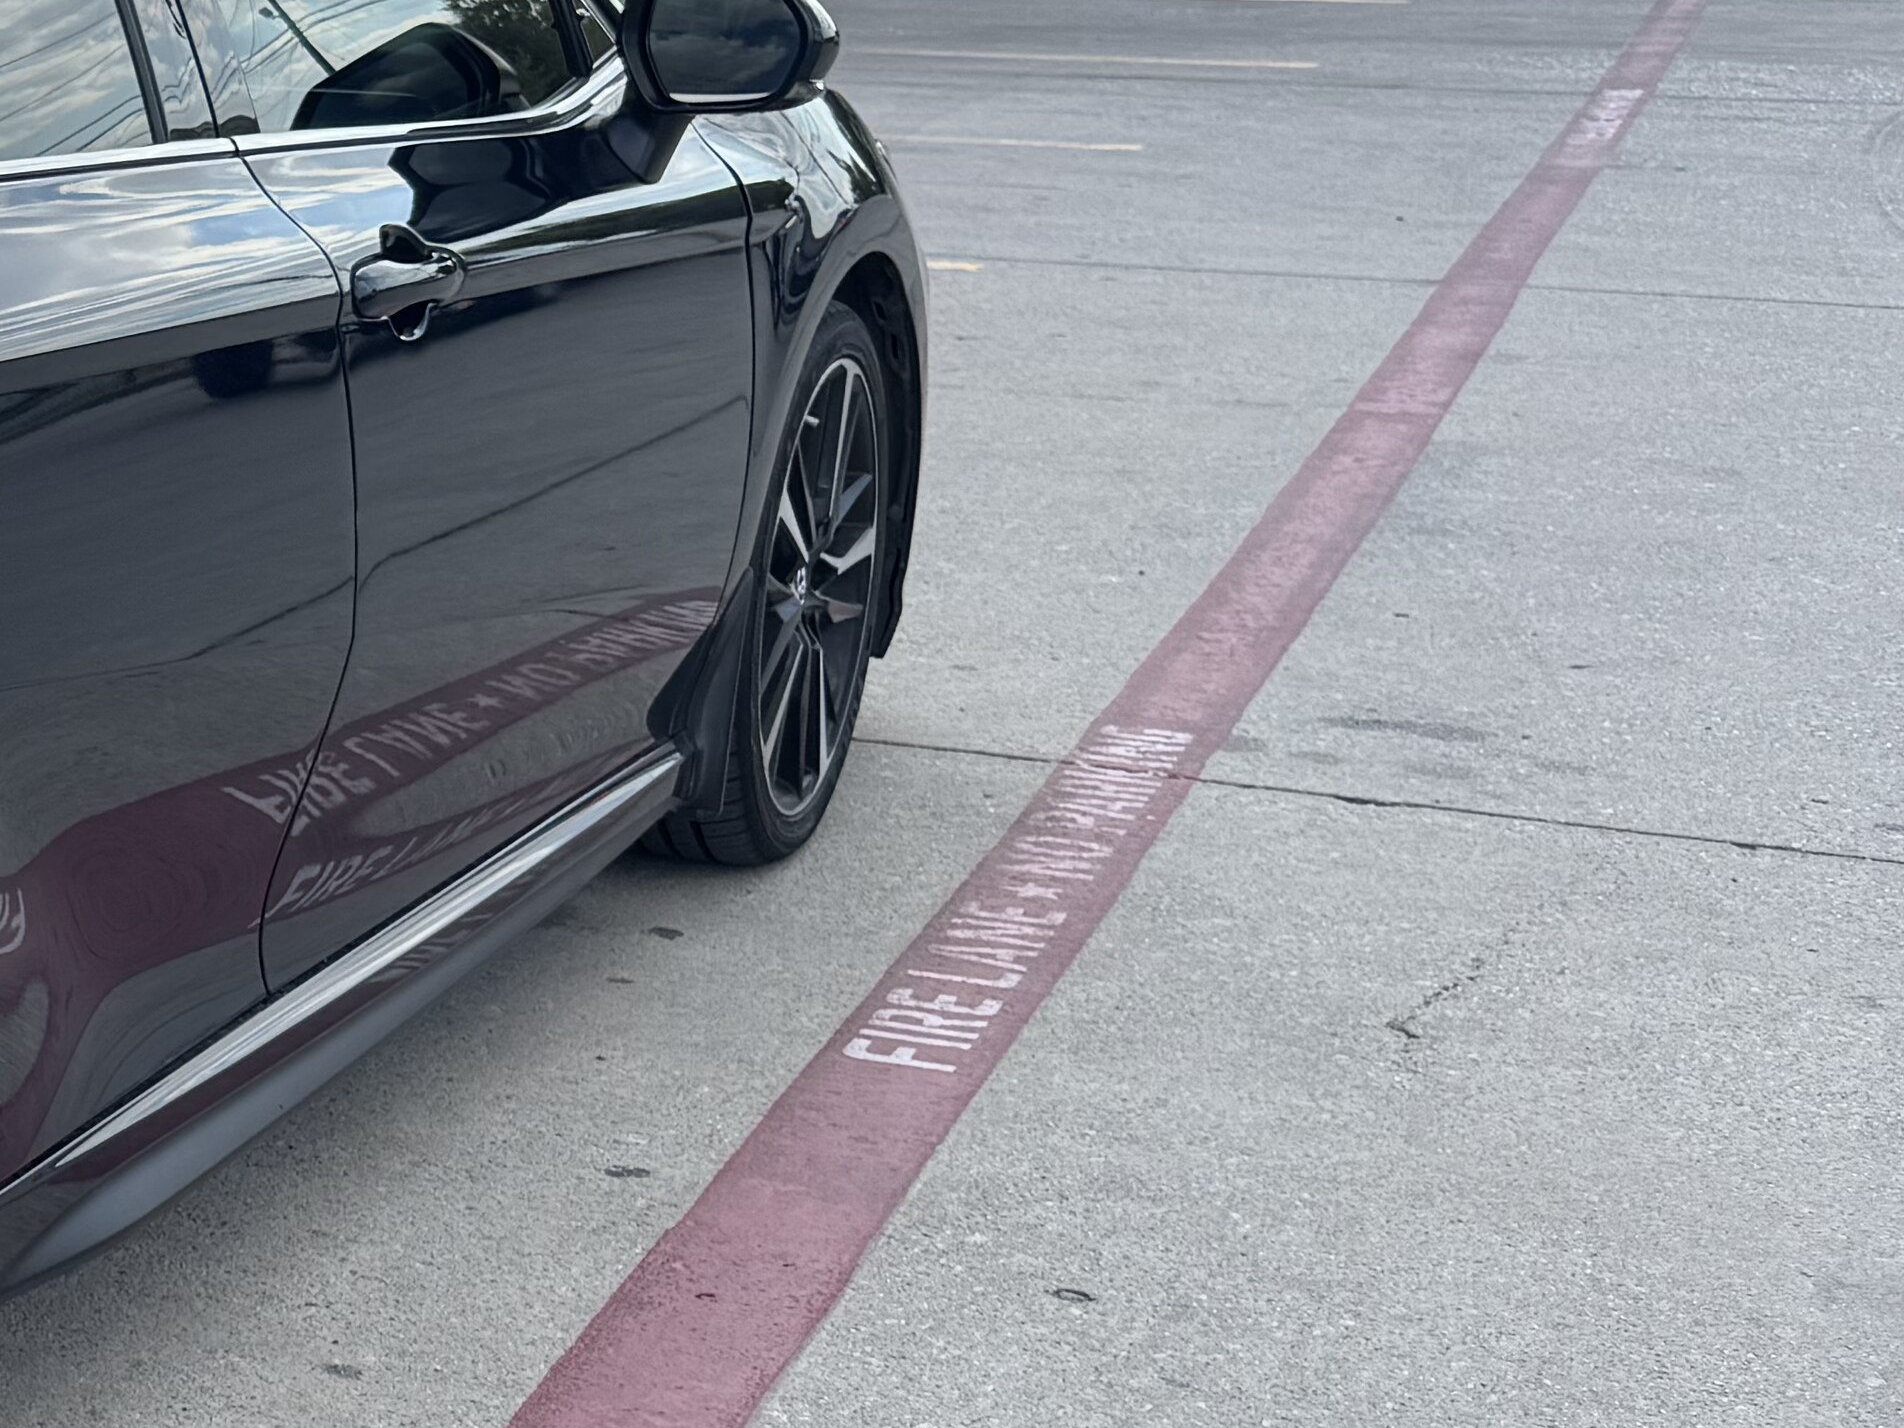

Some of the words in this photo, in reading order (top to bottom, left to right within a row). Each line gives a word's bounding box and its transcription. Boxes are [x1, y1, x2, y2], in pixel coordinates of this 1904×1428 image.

[995, 836, 1114, 881] NO
[907, 901, 1067, 988] LANE
[843, 988, 1003, 1072] FIRE
